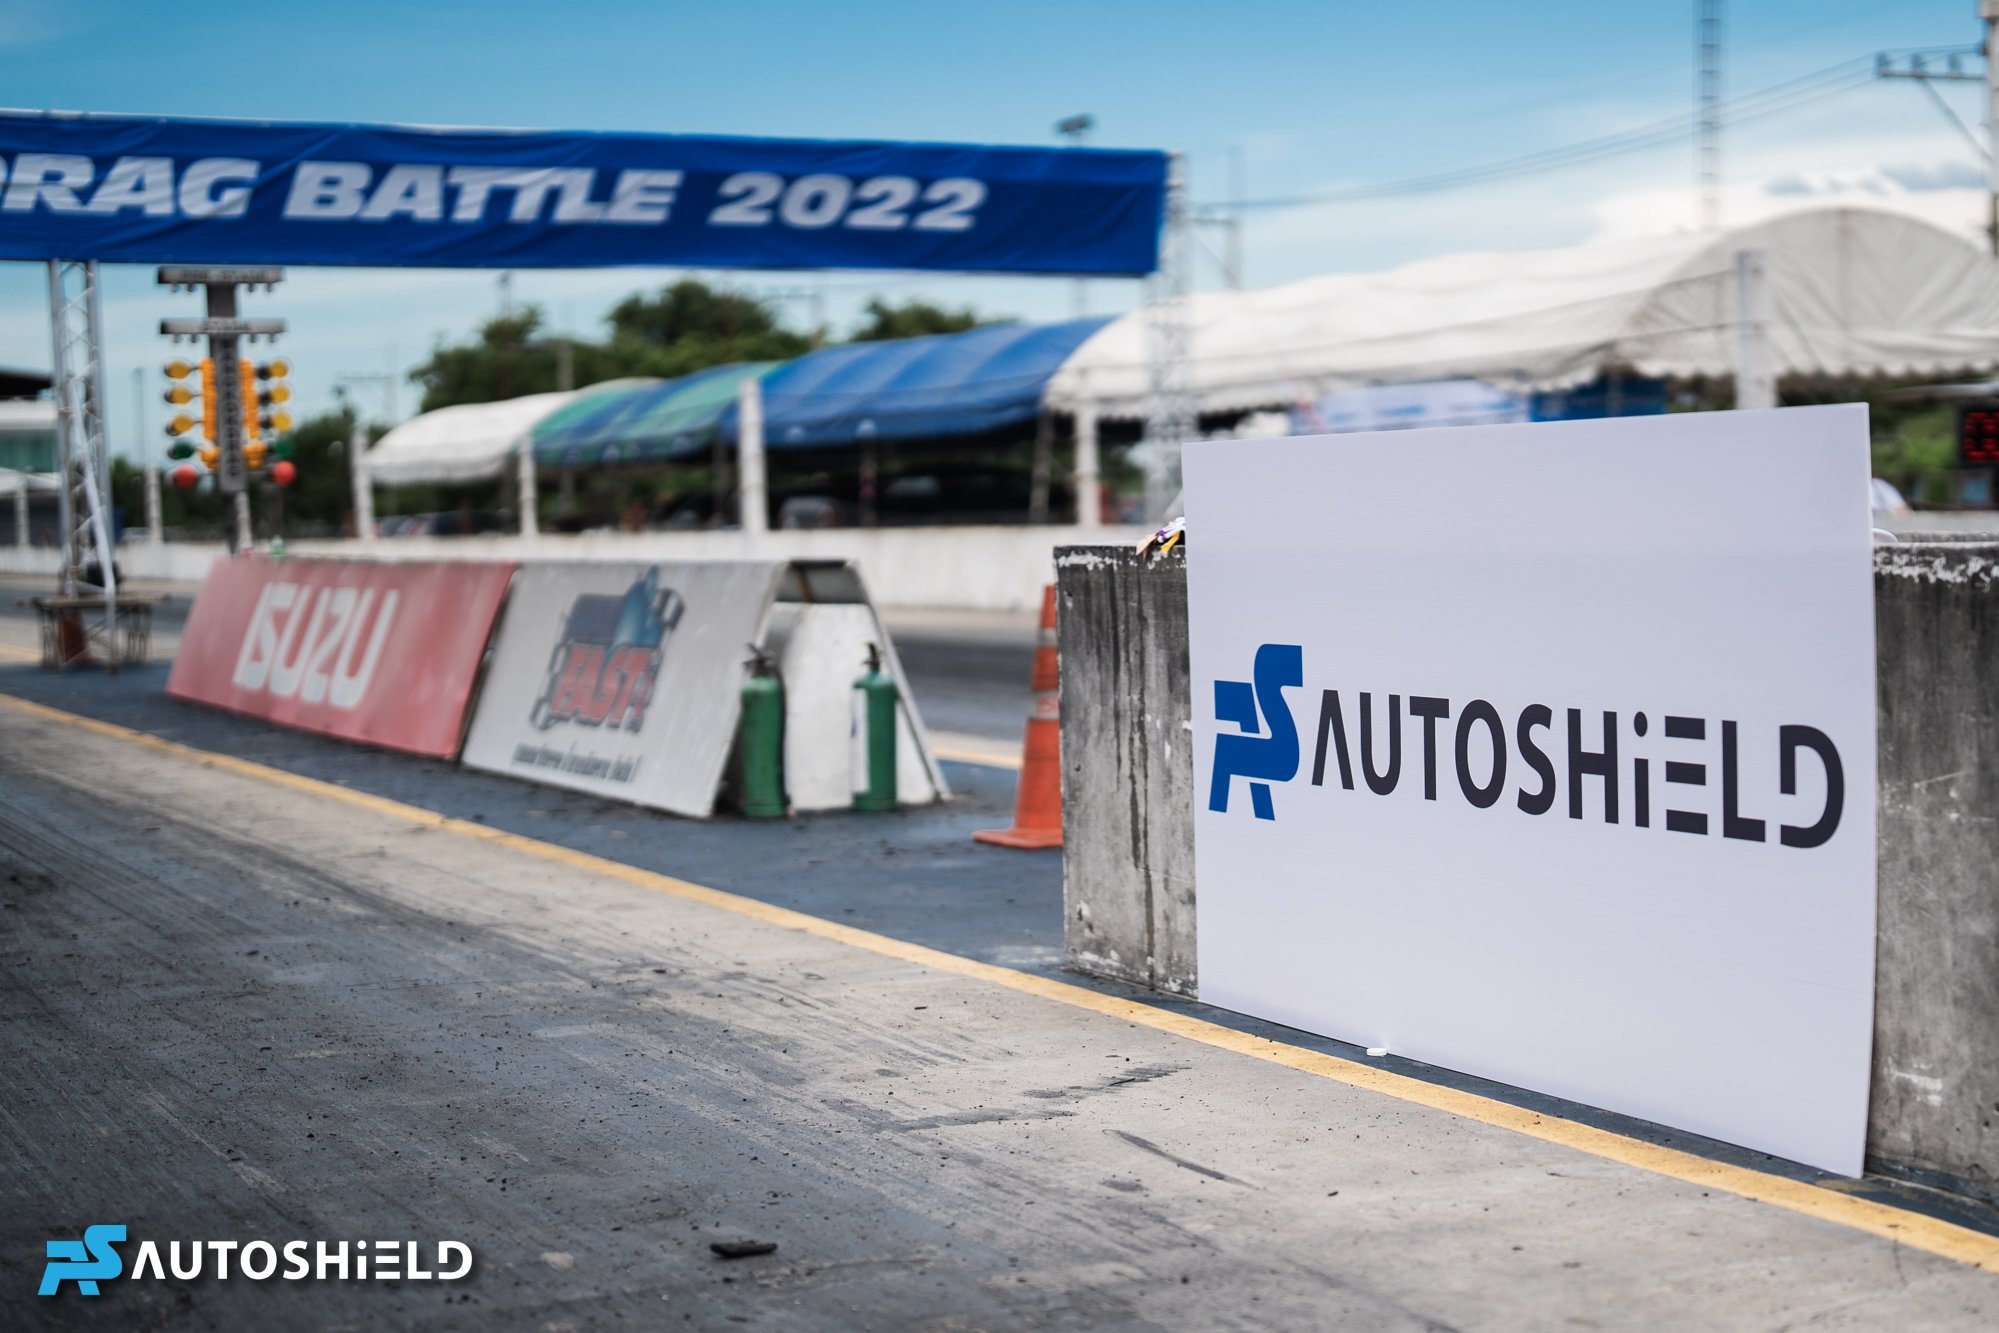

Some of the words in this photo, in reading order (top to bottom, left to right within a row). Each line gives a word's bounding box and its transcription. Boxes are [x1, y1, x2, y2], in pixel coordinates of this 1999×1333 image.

[0, 153, 261, 218] RAG
[283, 161, 684, 223] BATTLE
[707, 171, 987, 231] 2022
[233, 581, 399, 709] ISUZU
